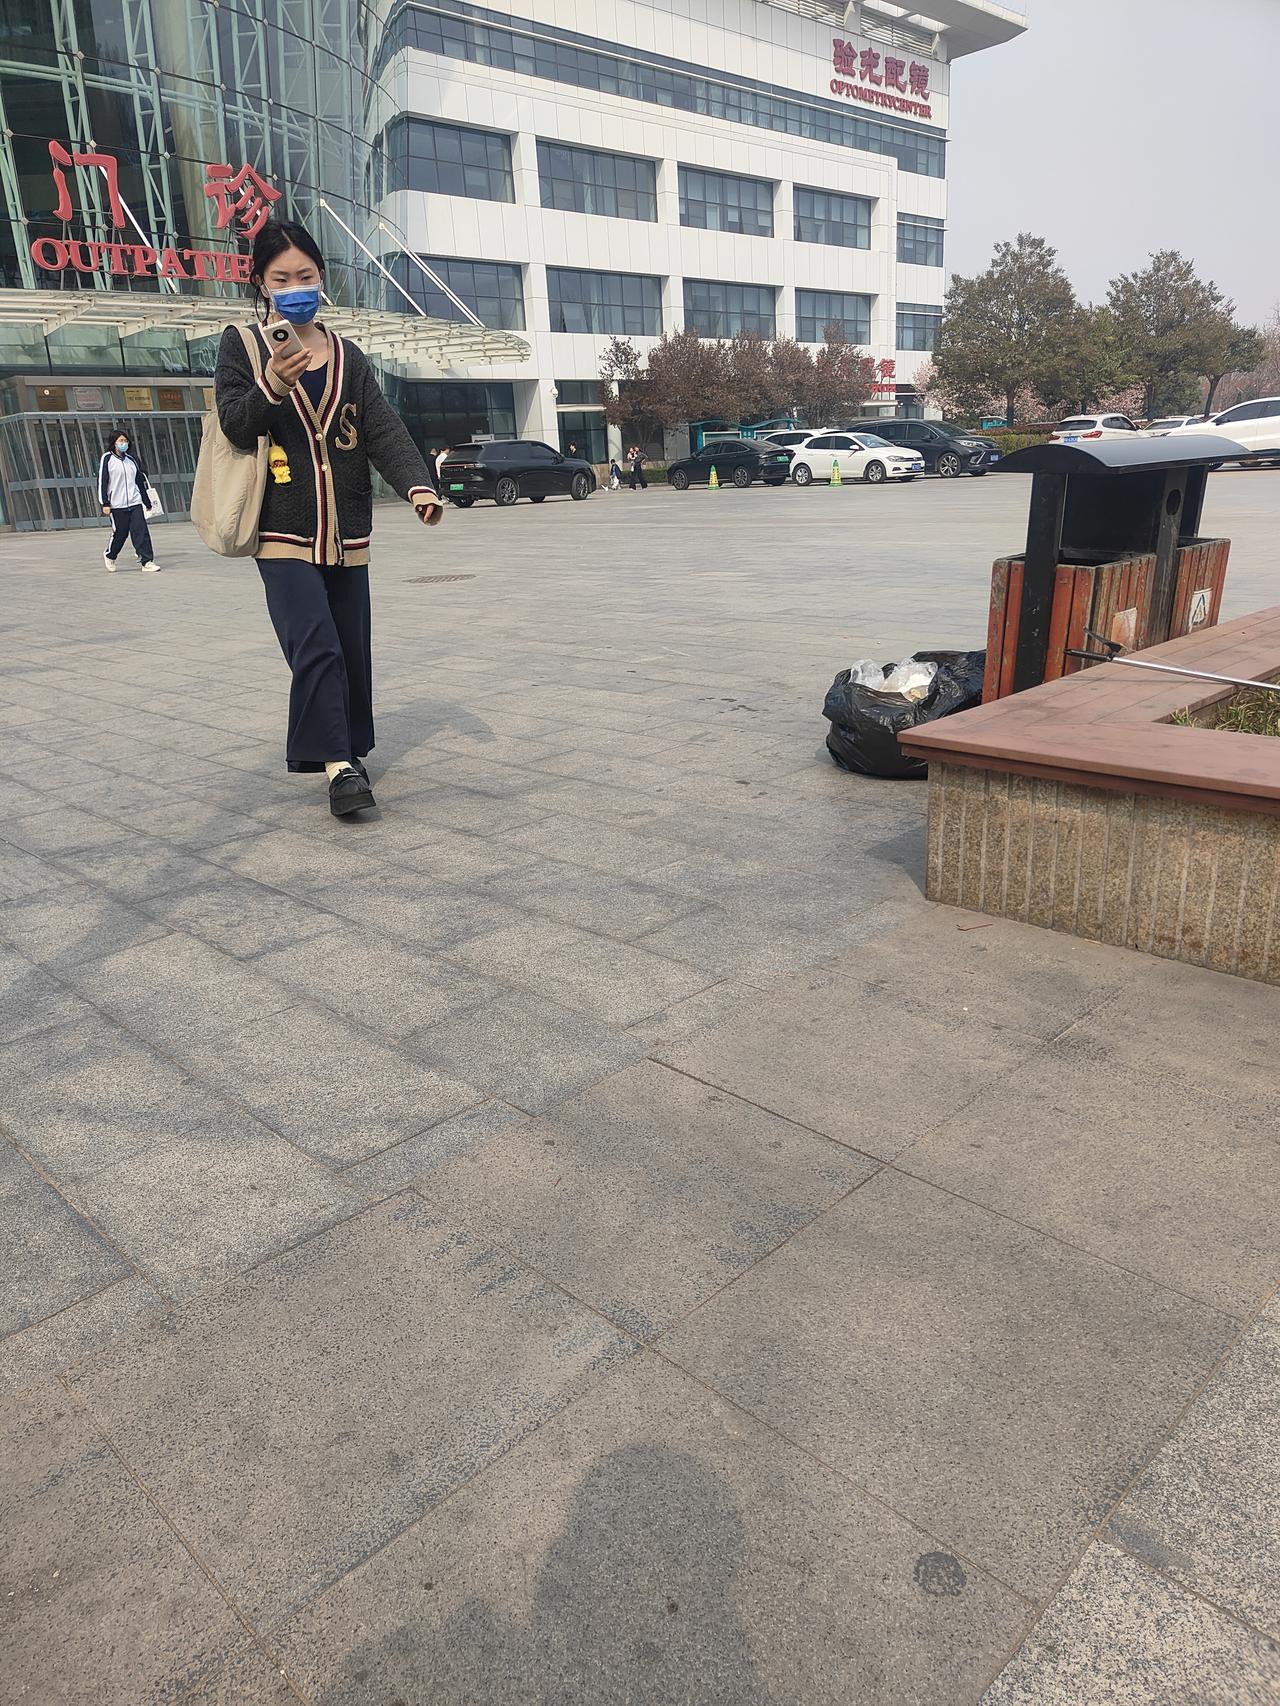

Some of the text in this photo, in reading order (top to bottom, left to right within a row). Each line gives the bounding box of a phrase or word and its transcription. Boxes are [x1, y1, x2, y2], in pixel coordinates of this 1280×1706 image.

[832, 38, 931, 101] 验光配镜
[48, 139, 282, 240] 门诊
[31, 237, 253, 284] OUTPATIE
[335, 402, 358, 450] S
